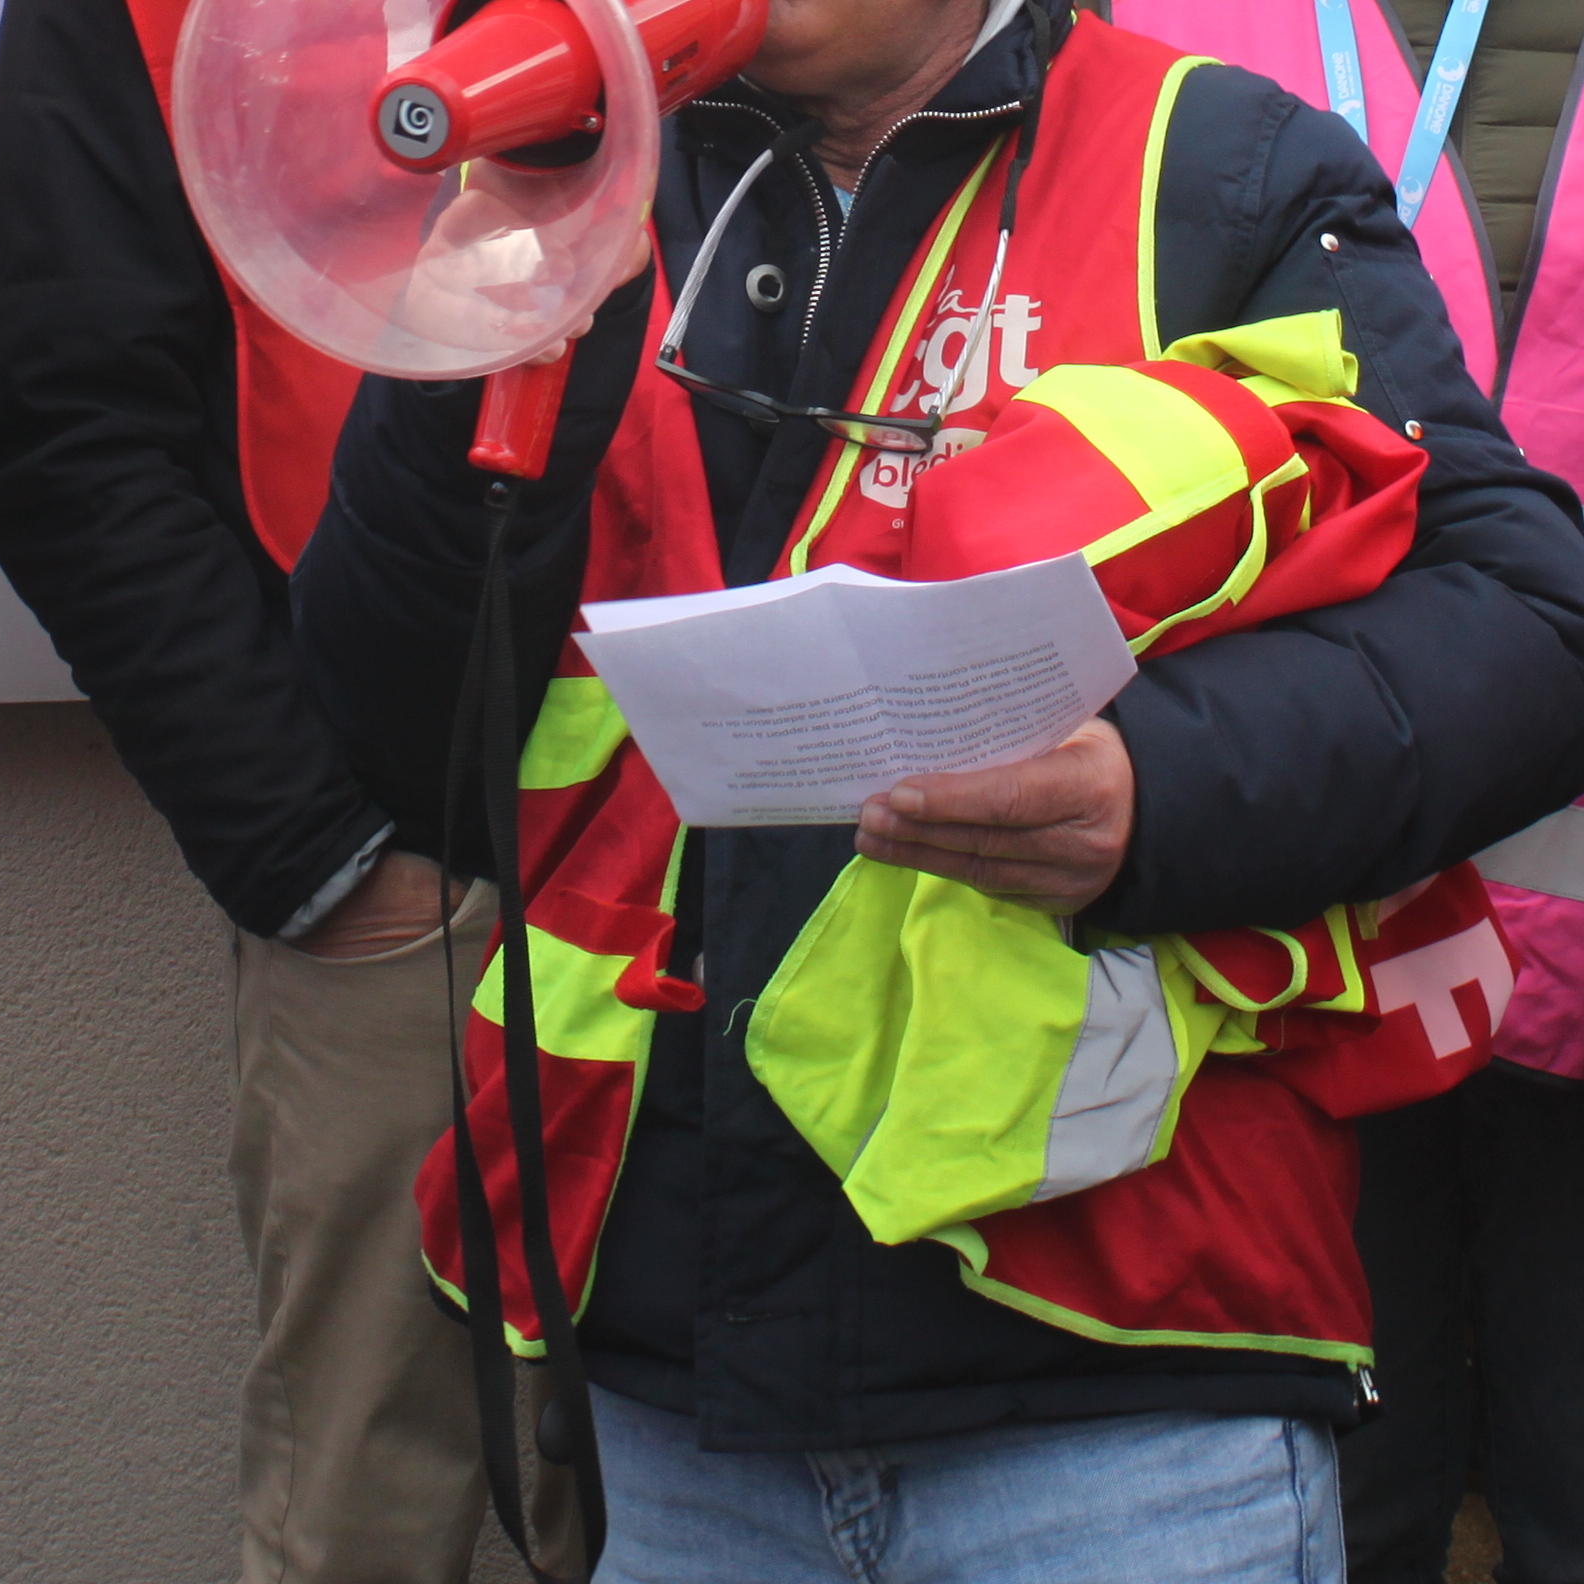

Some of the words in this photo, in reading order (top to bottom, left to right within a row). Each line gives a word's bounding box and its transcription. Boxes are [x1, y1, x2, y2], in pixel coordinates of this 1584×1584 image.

[1012, 652, 1058, 672] effectifs
[942, 680, 969, 692] Plan
[980, 680, 1010, 693] nous
[1004, 676, 1055, 698] toutefois
[928, 689, 978, 705] sommes
[834, 698, 884, 716] accepter
[742, 714, 805, 727] adaptation
[916, 710, 998, 738] contrairement
[994, 714, 1028, 728] Leurs
[766, 726, 808, 739] rapport
[847, 727, 897, 745] scénario
[956, 726, 992, 744] 4000T
[992, 723, 1034, 741] inverse
[862, 742, 892, 756] 000T
[946, 743, 981, 758] savoir
[816, 761, 866, 774] volumes
[882, 765, 913, 776] revoir
[932, 756, 978, 772] Danone
[821, 774, 854, 786] projet
